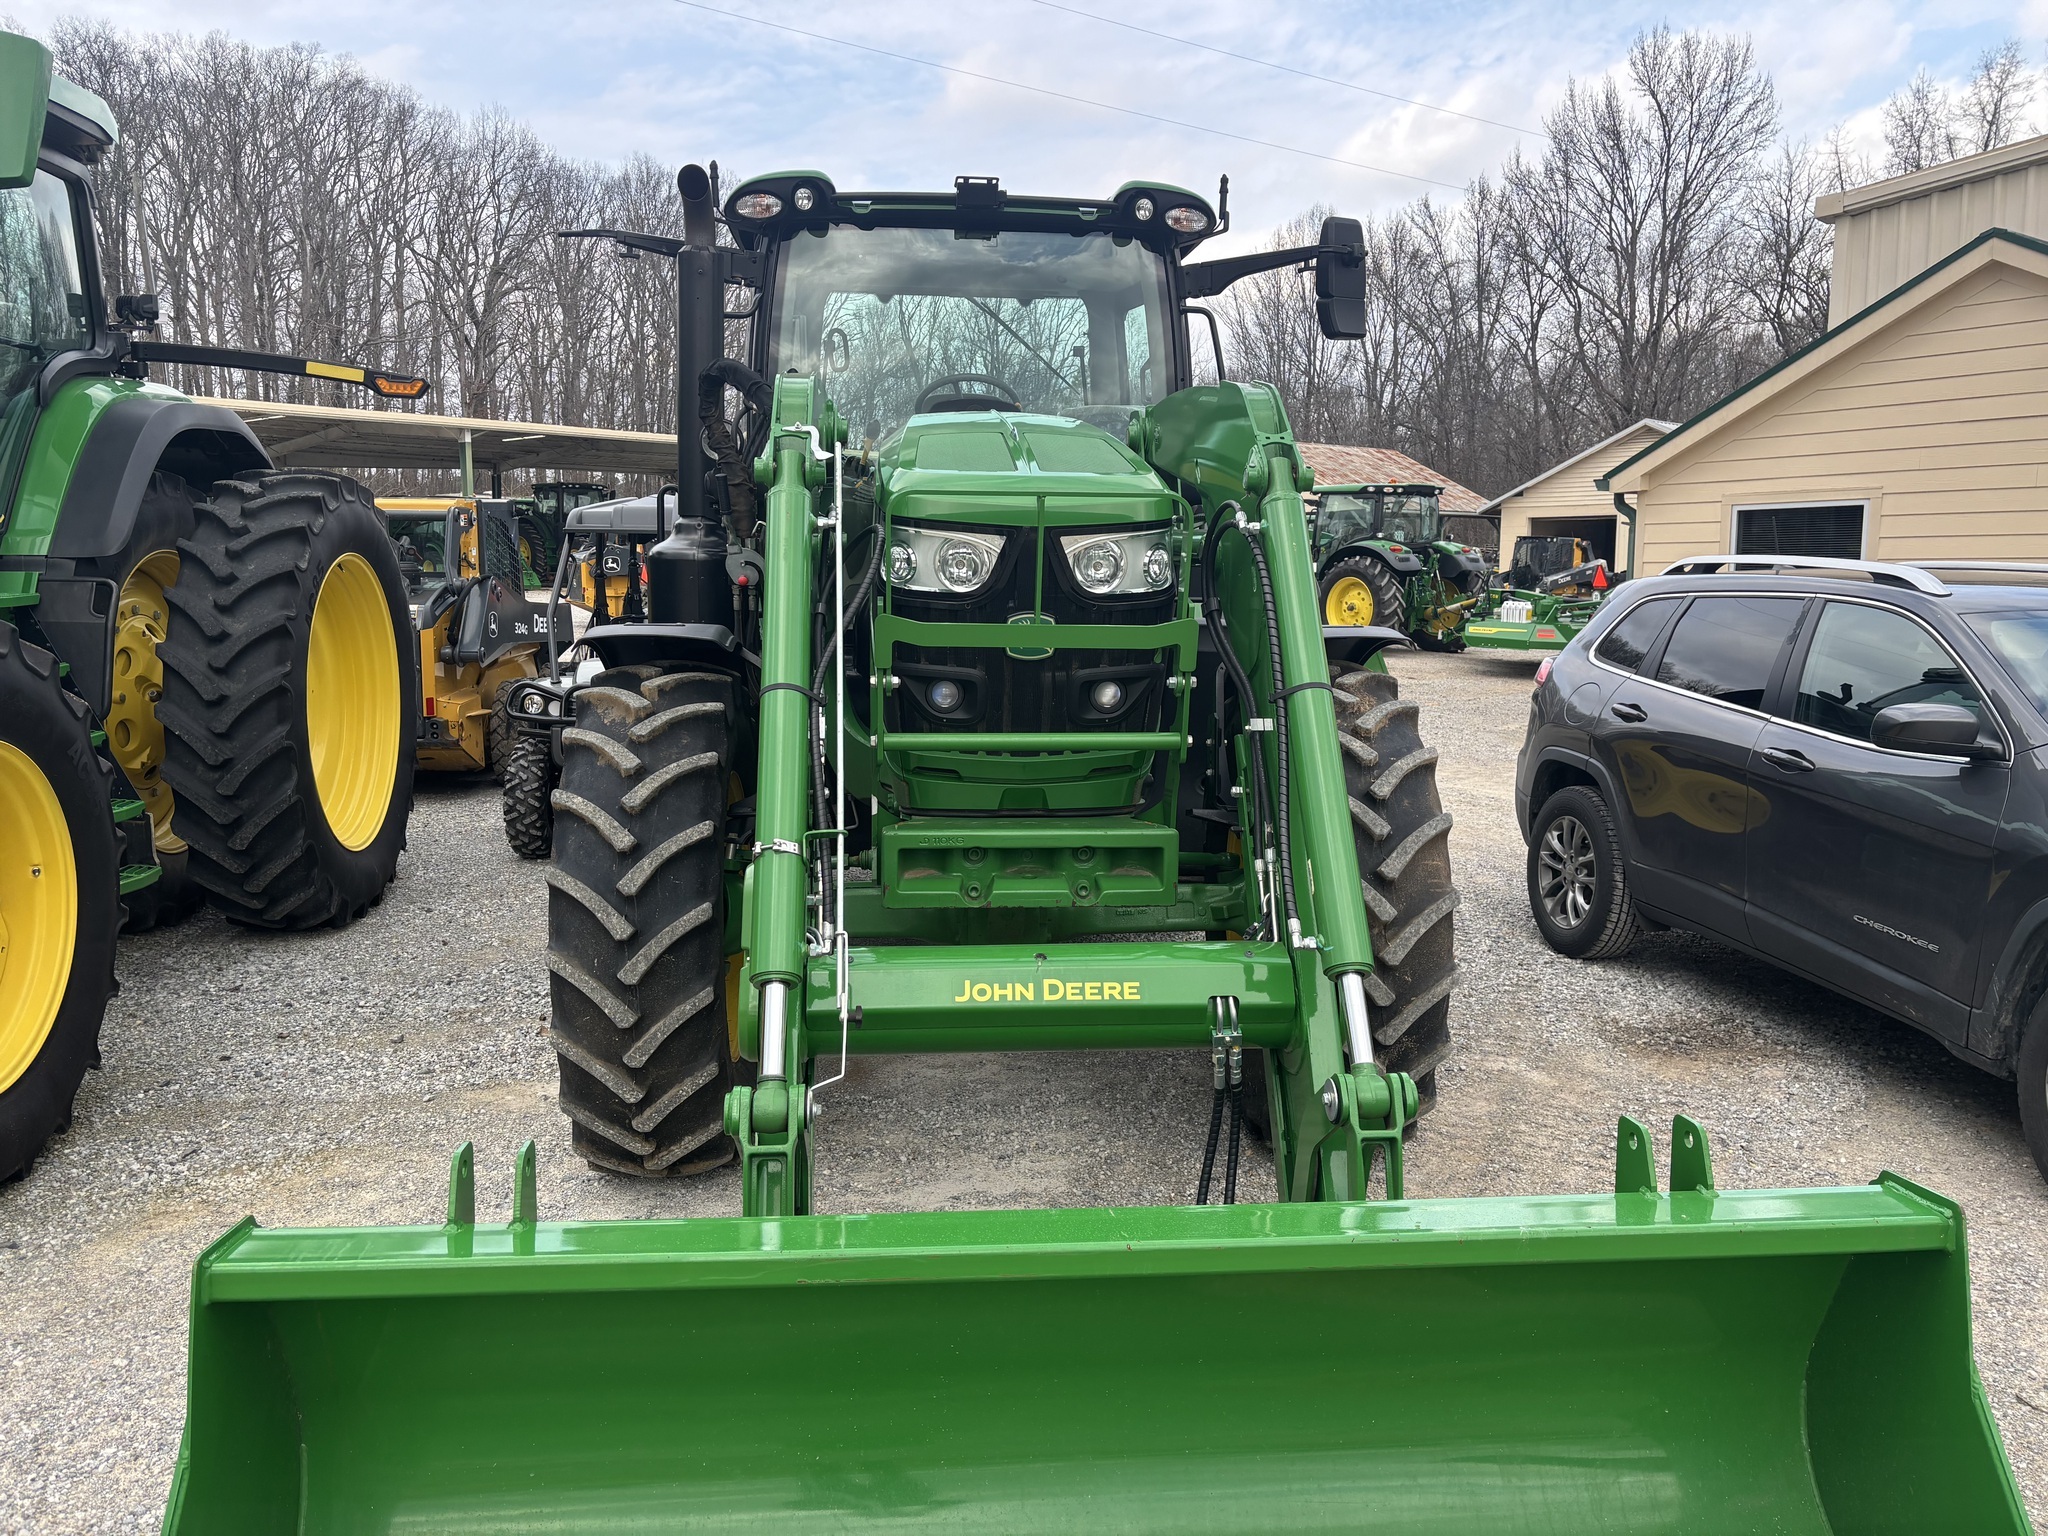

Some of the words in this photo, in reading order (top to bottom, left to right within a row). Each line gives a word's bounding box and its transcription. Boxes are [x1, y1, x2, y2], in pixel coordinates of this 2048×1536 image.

[514, 622, 528, 635] 324G
[533, 613, 557, 633] DEEE
[1853, 914, 1940, 953] CHEROKEE
[954, 979, 1034, 1003] JOHN
[1042, 978, 1141, 1001] DEERE
